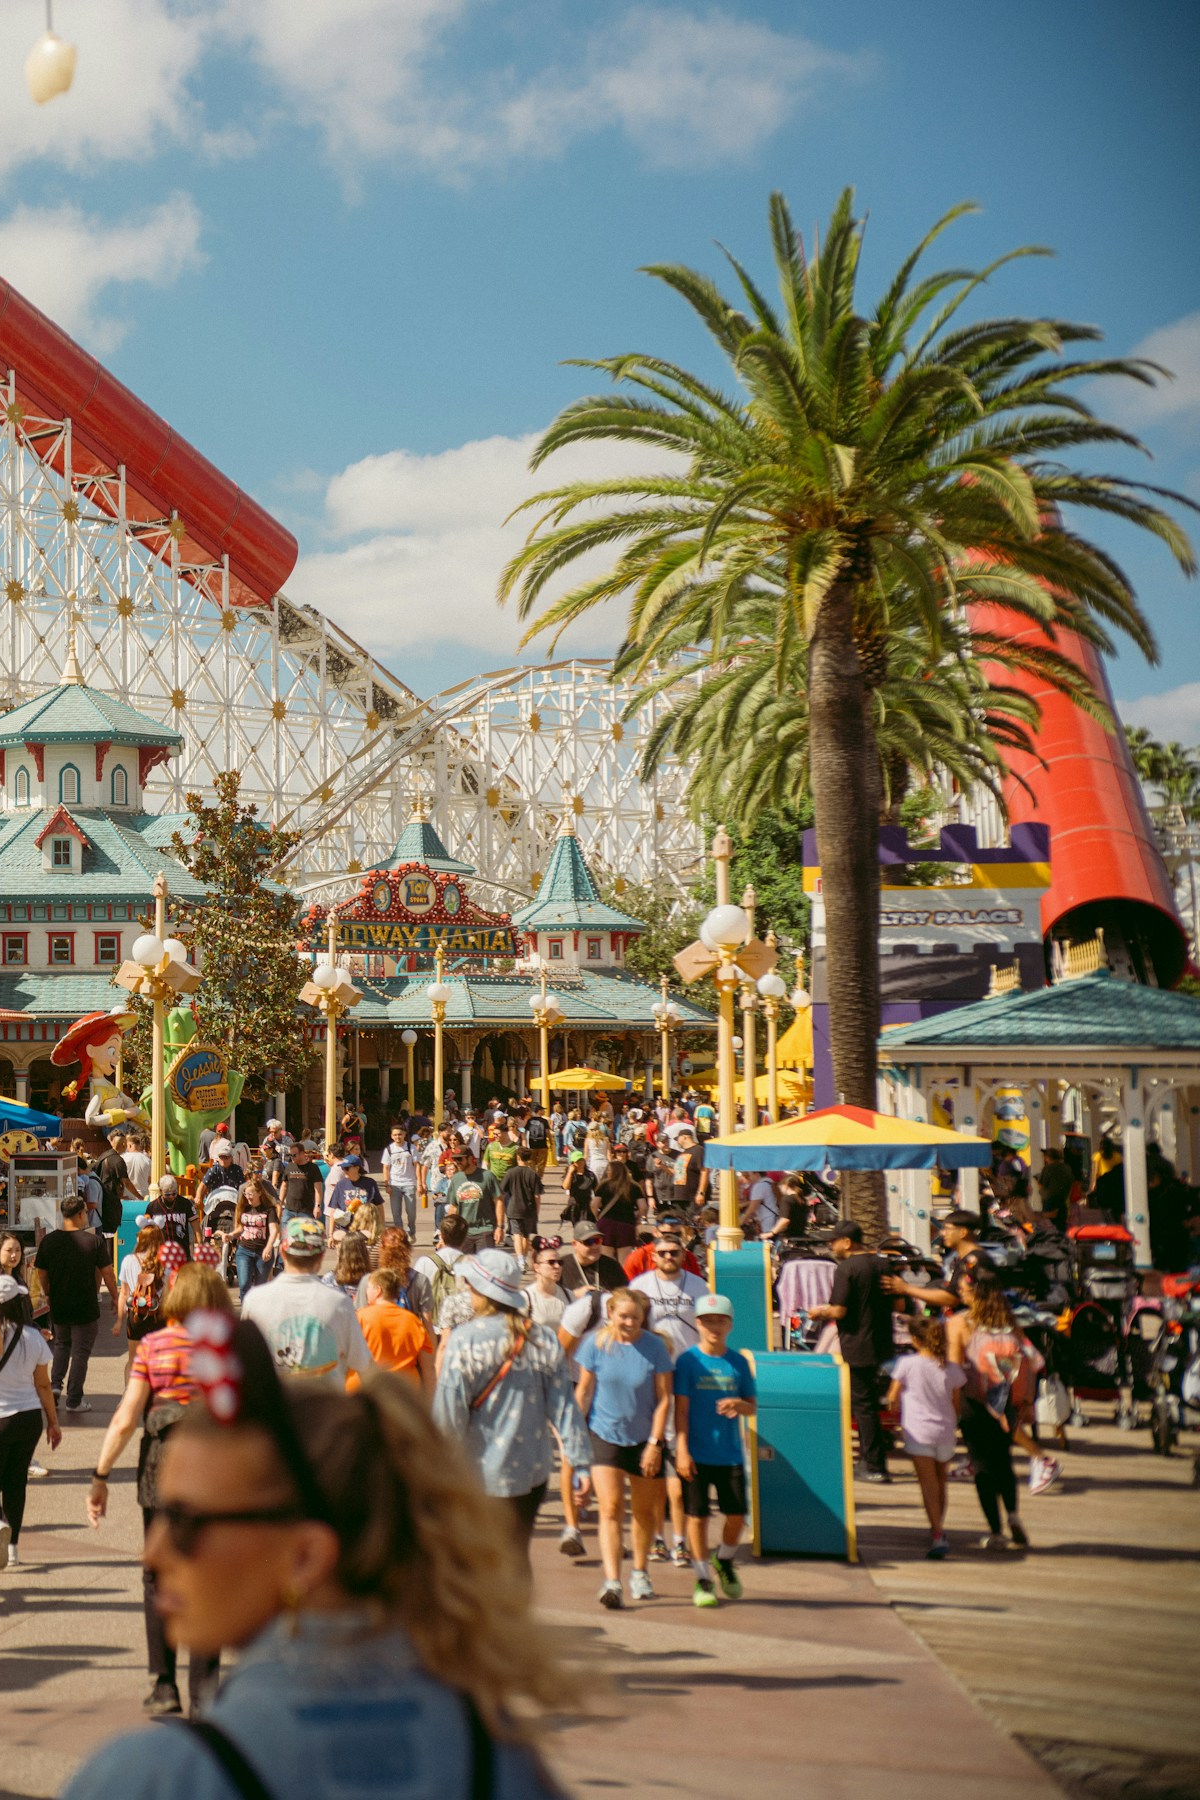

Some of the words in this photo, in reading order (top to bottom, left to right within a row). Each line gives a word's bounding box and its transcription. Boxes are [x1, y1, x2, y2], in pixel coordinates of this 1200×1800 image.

[408, 880, 429, 895] TOY
[880, 910, 930, 926] LTRY
[933, 909, 1021, 925] PALACE
[428, 927, 512, 951] MANIA!
